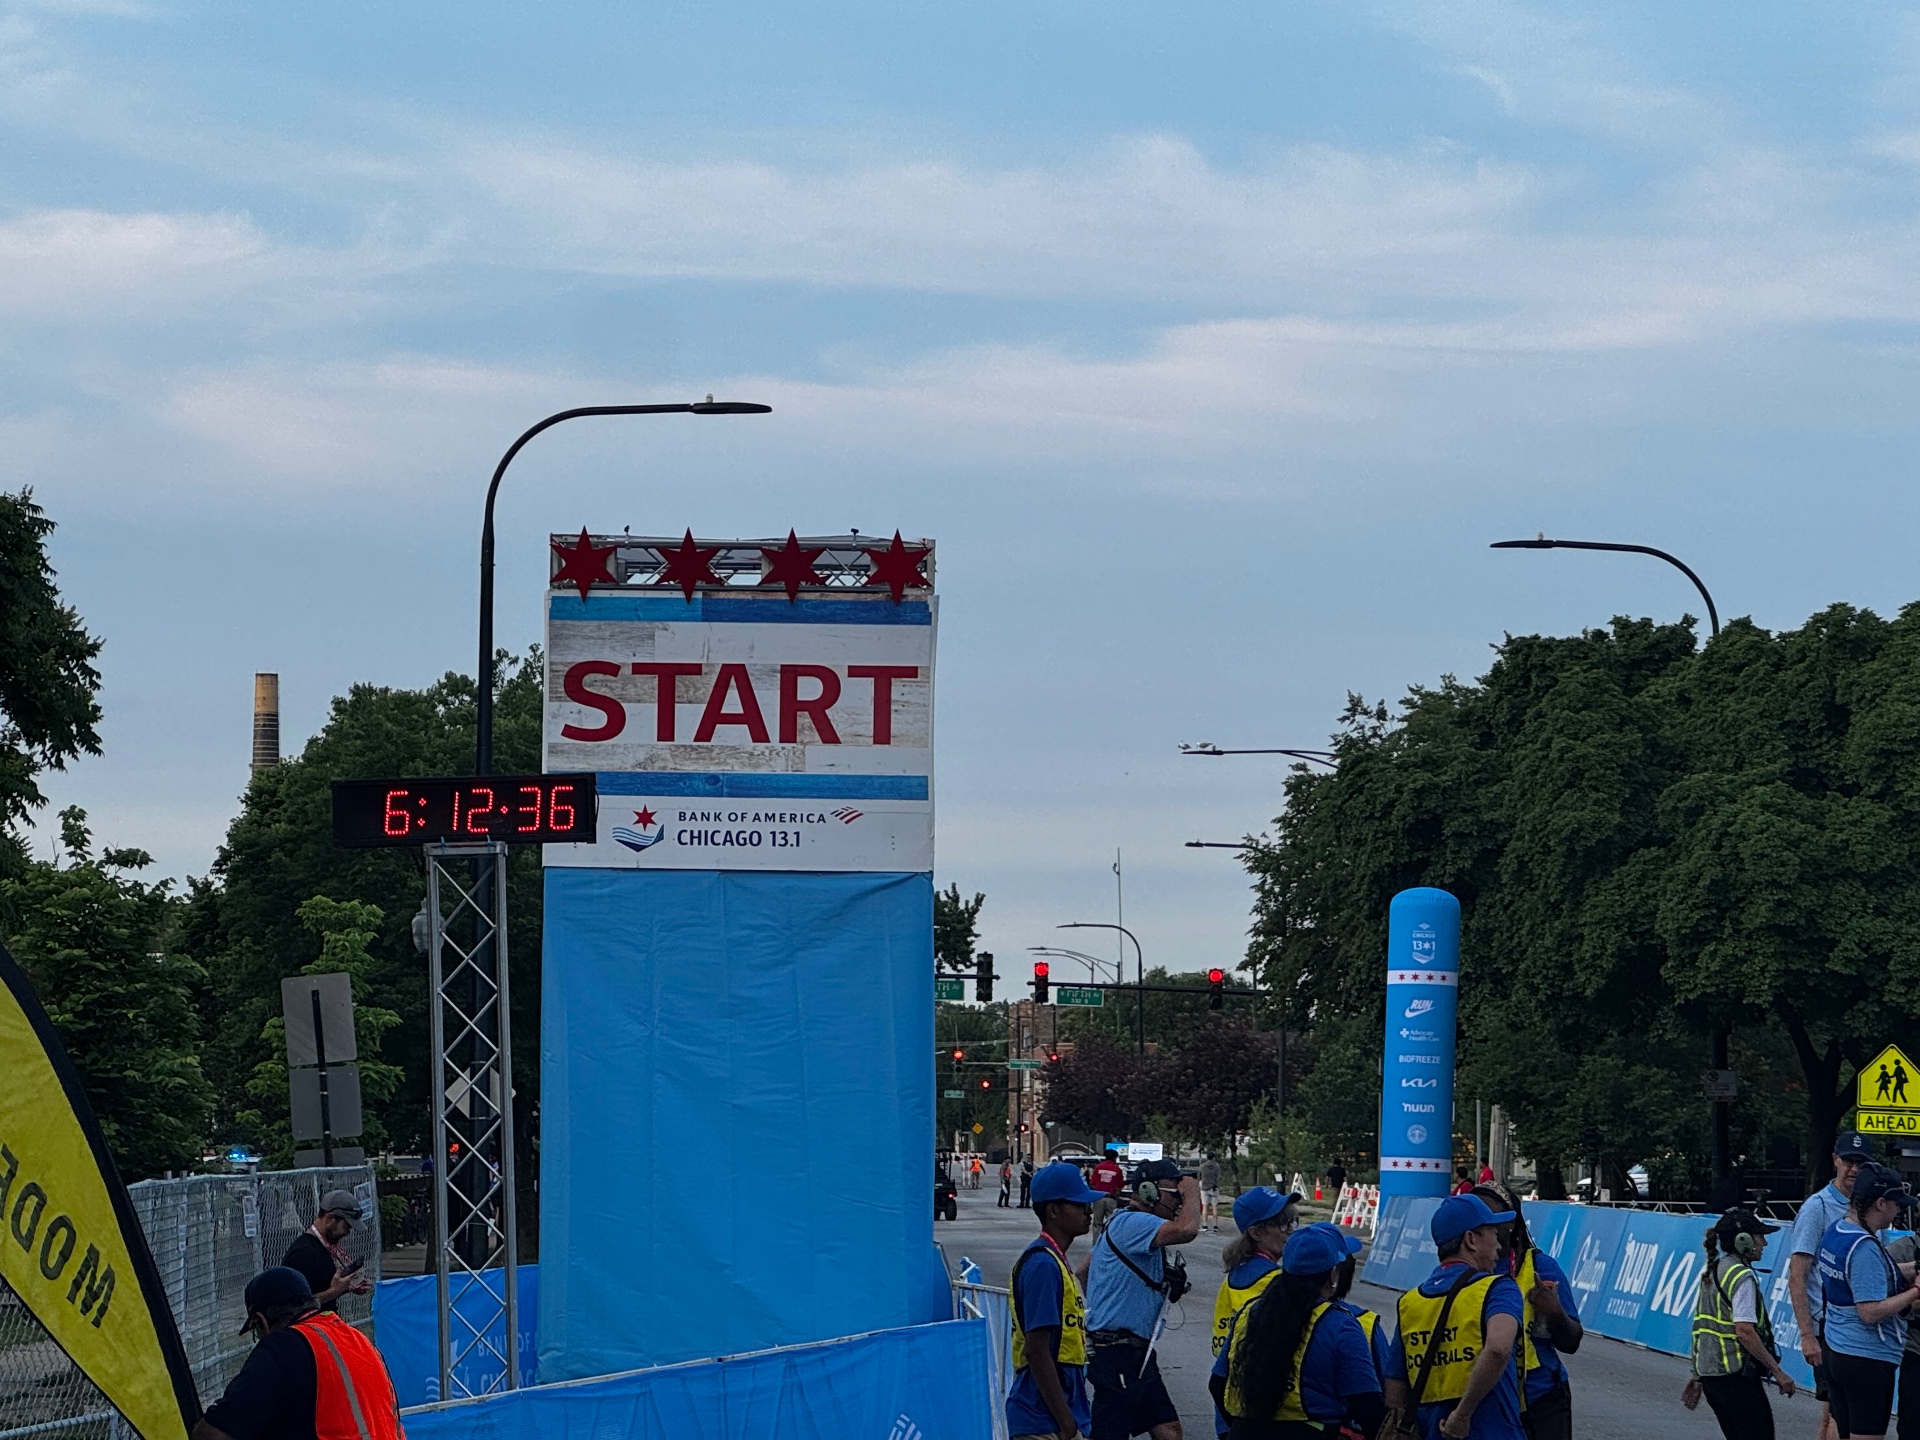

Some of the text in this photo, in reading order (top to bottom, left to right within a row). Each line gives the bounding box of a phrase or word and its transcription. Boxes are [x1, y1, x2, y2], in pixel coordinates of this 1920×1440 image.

[560, 660, 919, 746] START
[678, 811, 827, 824] BANK OF AMERICA
[677, 829, 801, 848] CHICAGO 13.1
[1066, 990, 1091, 998] FIFTH
[1410, 999, 1433, 1010] RUN
[1864, 1115, 1917, 1130] AHEAD
[1410, 1326, 1459, 1347] STRT
[1407, 1346, 1476, 1370] CORALS
